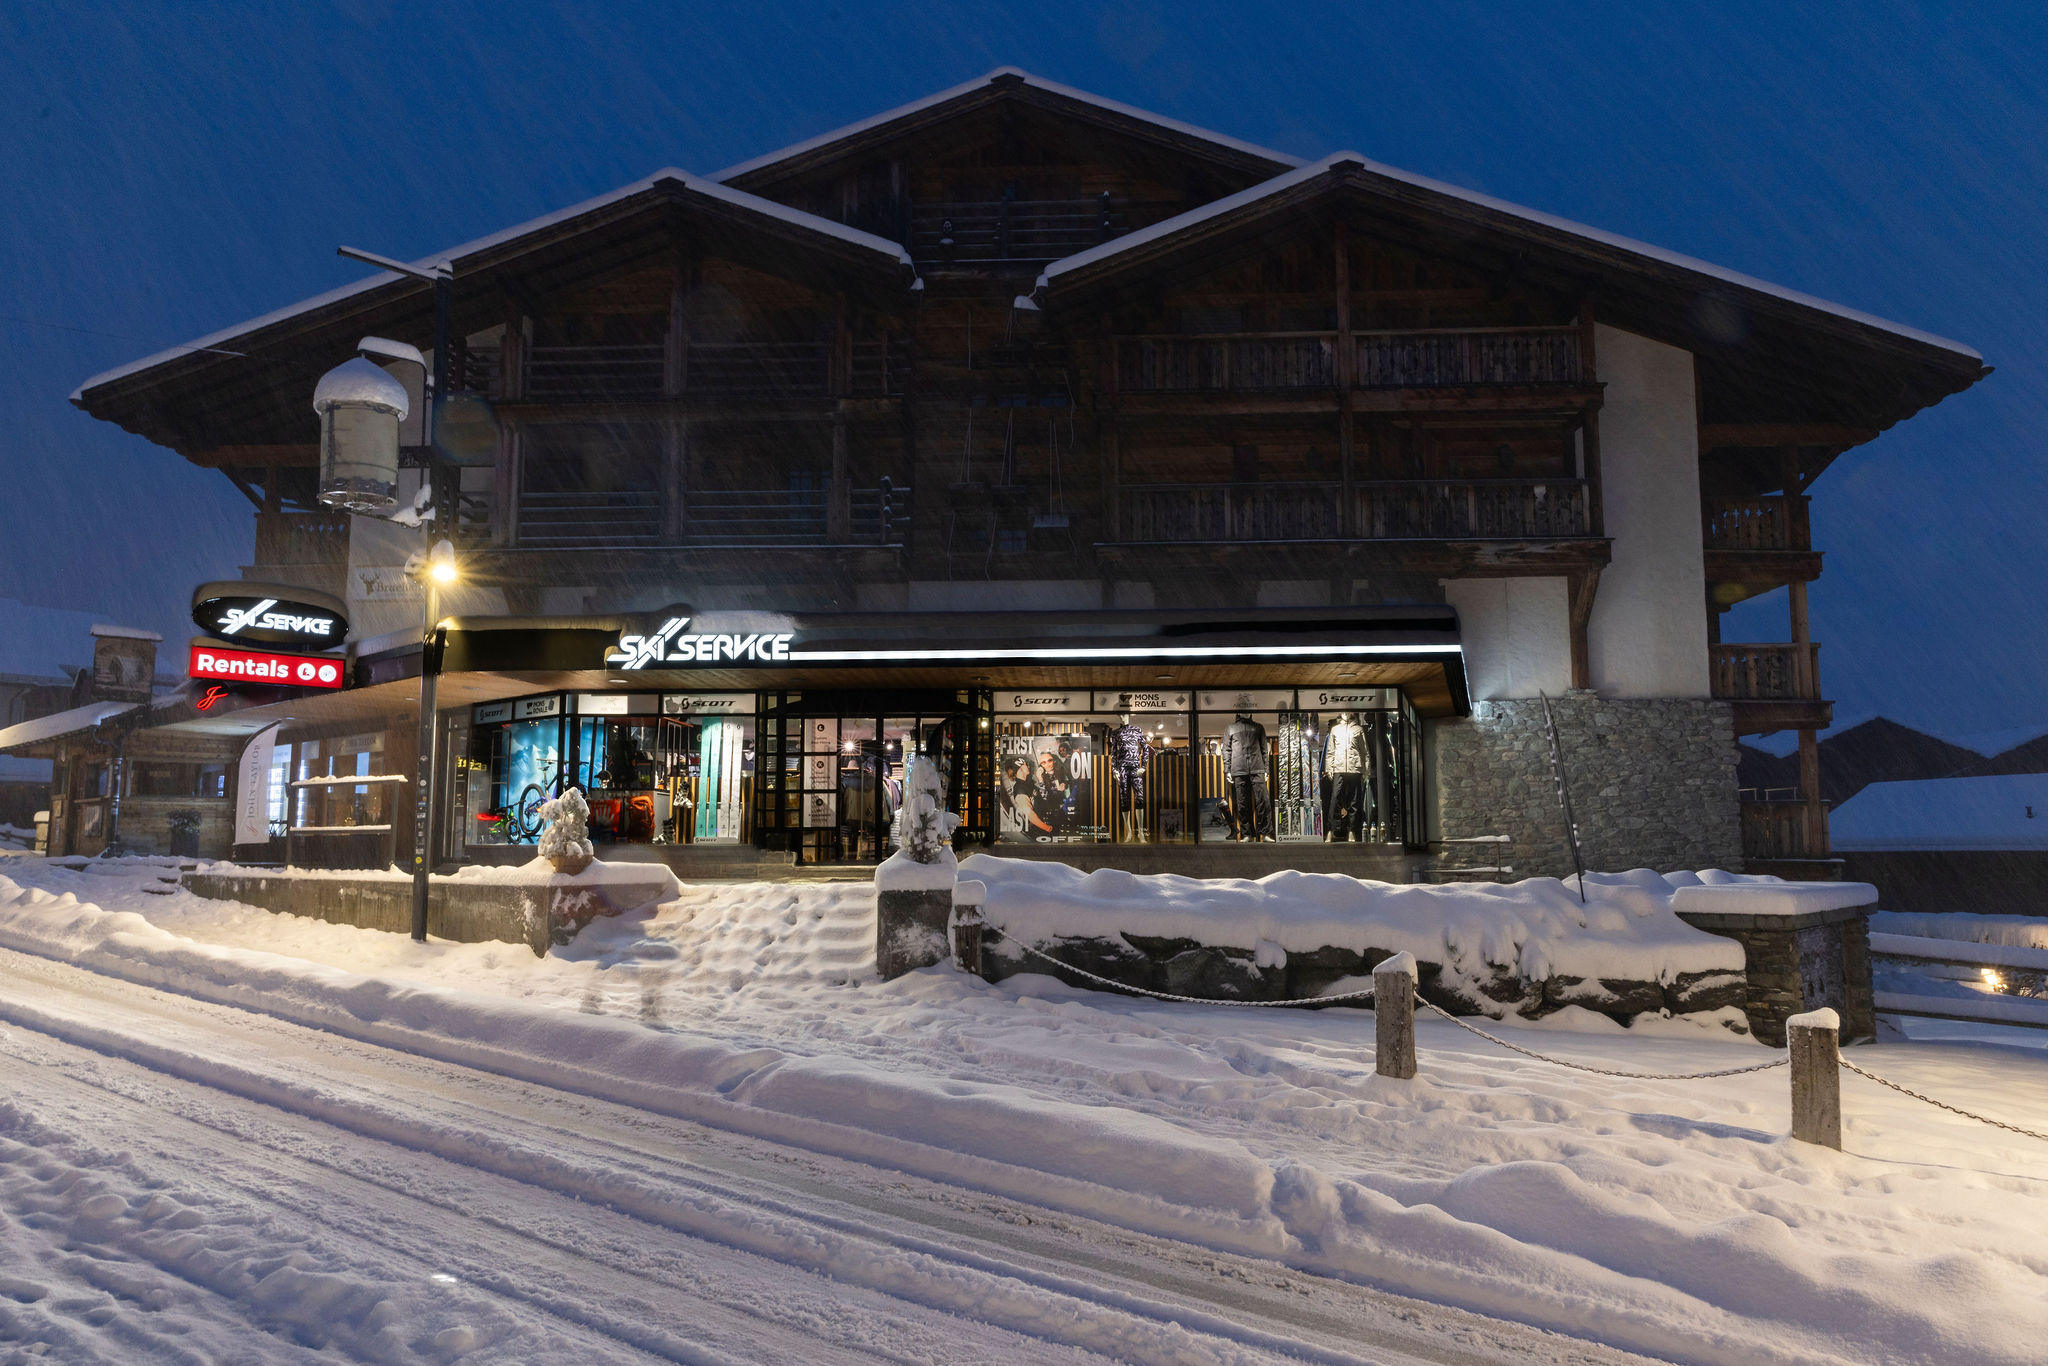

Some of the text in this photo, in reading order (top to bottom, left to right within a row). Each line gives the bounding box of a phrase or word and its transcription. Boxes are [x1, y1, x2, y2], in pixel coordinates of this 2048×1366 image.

[218, 599, 333, 635] SKI SERVICE
[606, 617, 794, 669] SKI SERVICE
[197, 653, 289, 678] Rentals
[1023, 697, 1069, 705] SCOTT
[1134, 700, 1167, 708] ROYALE
[1000, 736, 1034, 755] FIRST
[1070, 751, 1092, 780] ON
[1000, 806, 1029, 832] LAST
[1035, 835, 1083, 843] OFF
